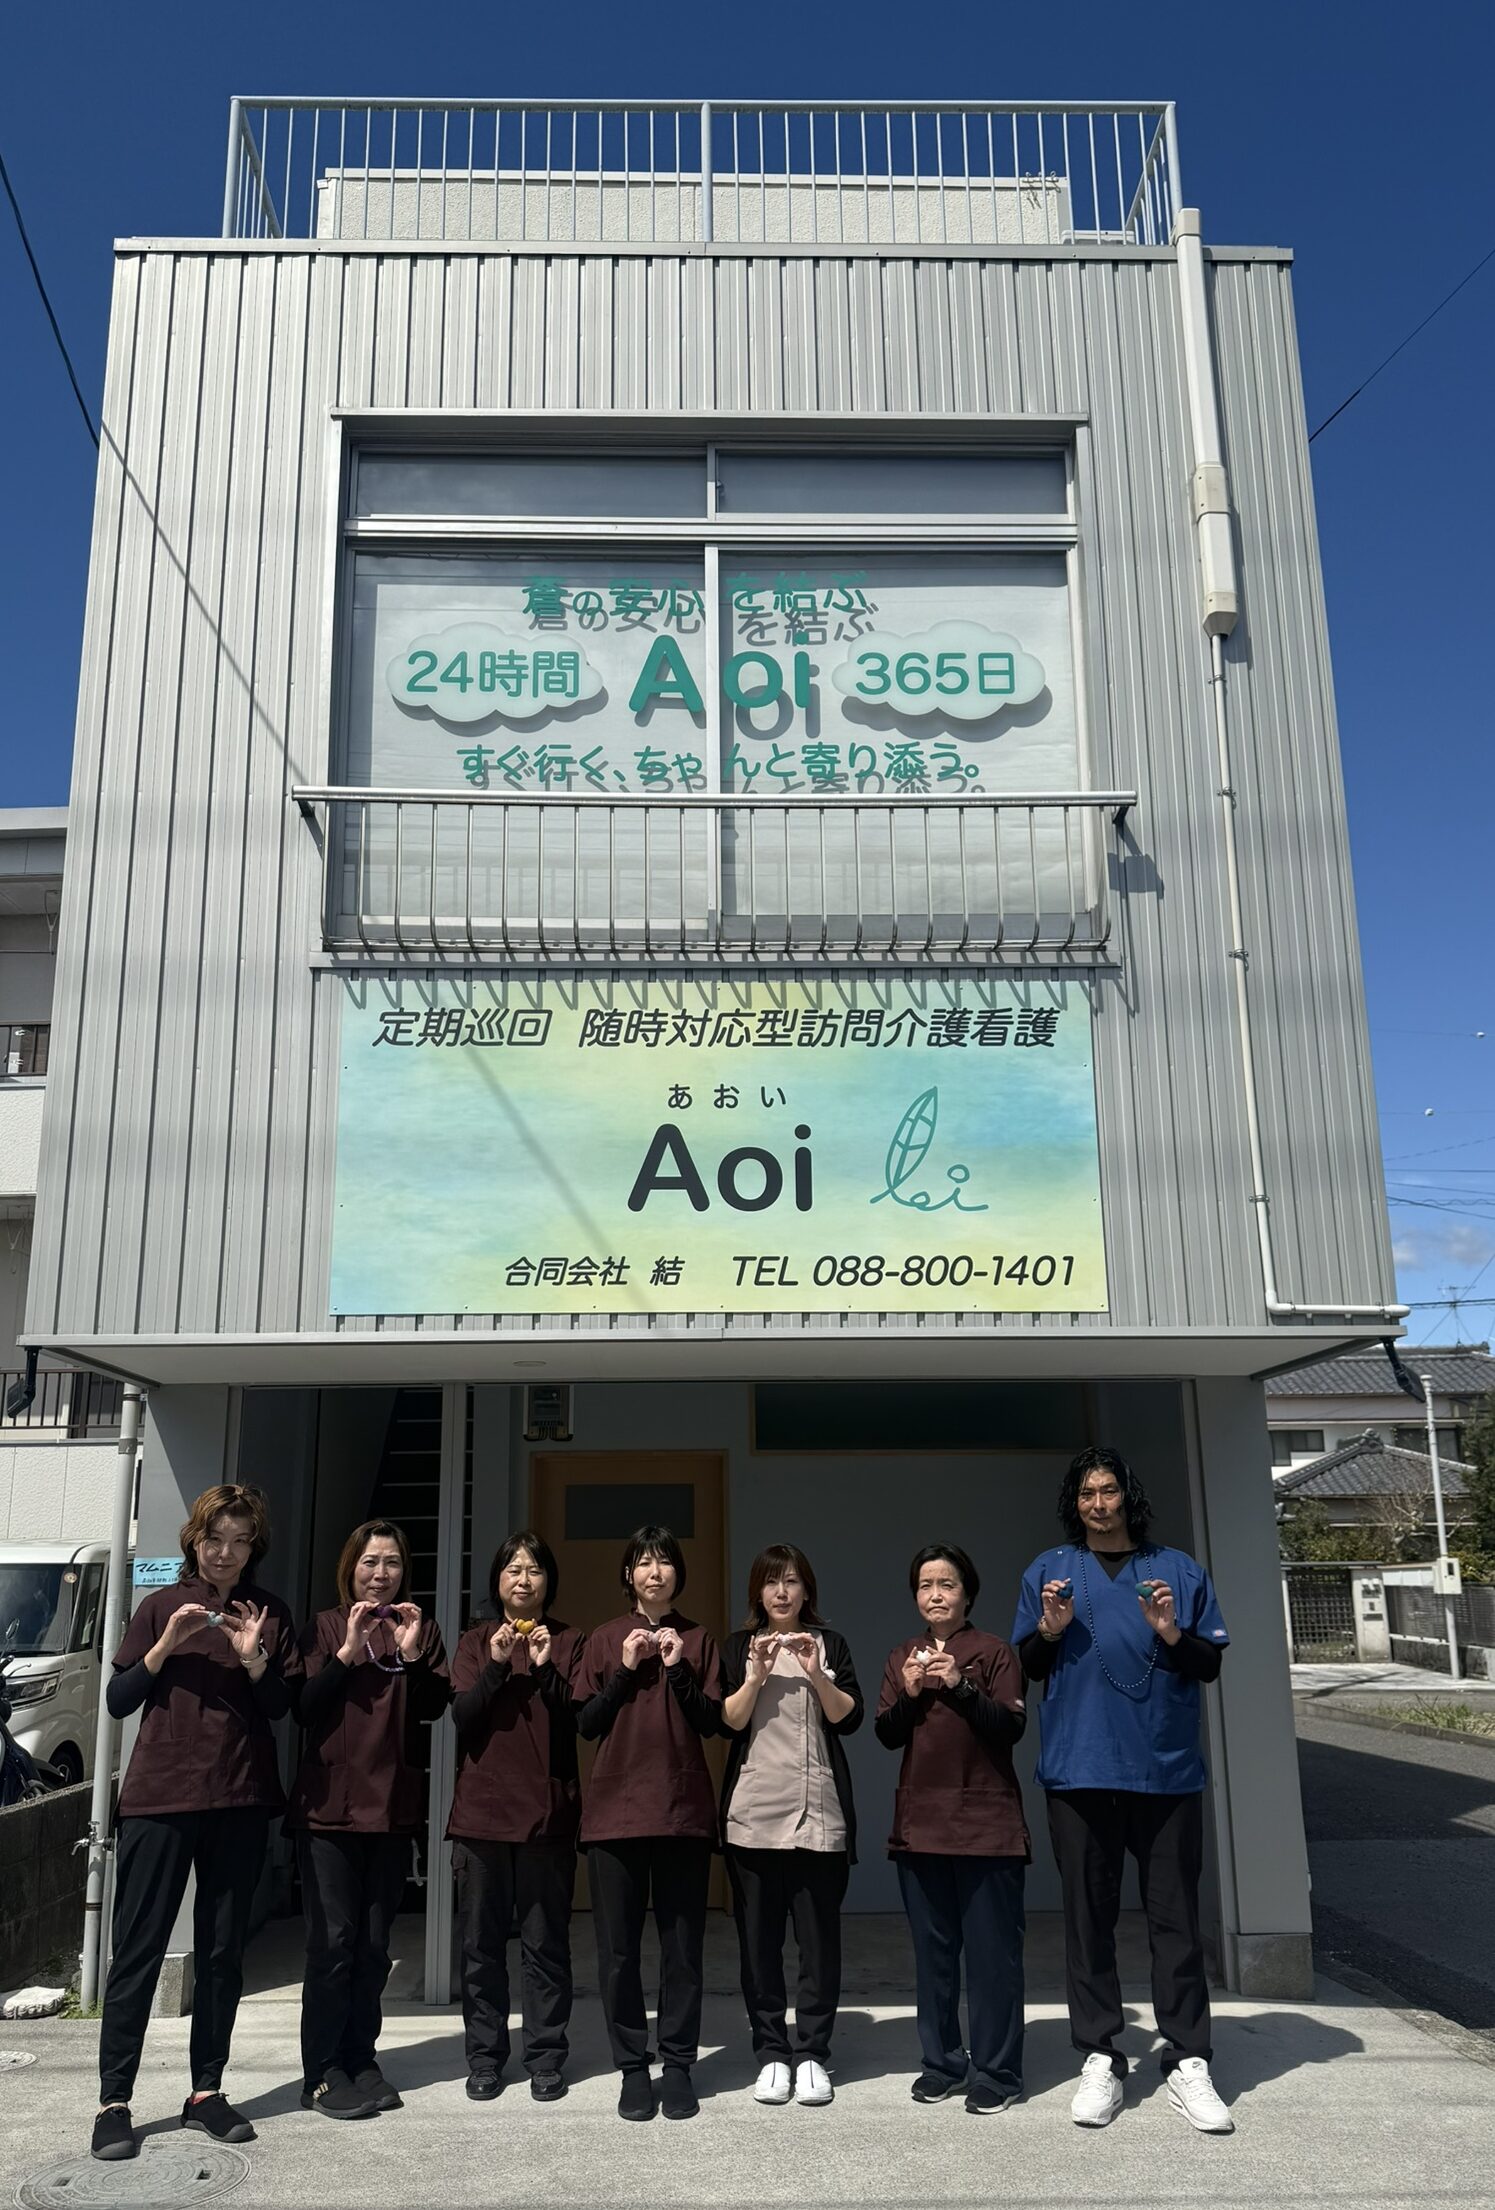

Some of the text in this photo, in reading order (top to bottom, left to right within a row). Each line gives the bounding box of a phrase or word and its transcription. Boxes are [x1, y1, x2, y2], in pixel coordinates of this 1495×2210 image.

[406, 651, 581, 699] 24時間
[628, 632, 812, 715] Aoi
[856, 652, 1016, 696] 365日
[456, 741, 980, 783] すぐ行く、ちゃんと寄り添う。
[372, 1009, 1062, 1049] 定期巡回 随時対応型訪問介護看護
[668, 1084, 788, 1111] あおい
[627, 1123, 814, 1213] Aoi
[505, 1256, 1076, 1289] 合同会社 結 TEL 088-800-1401
